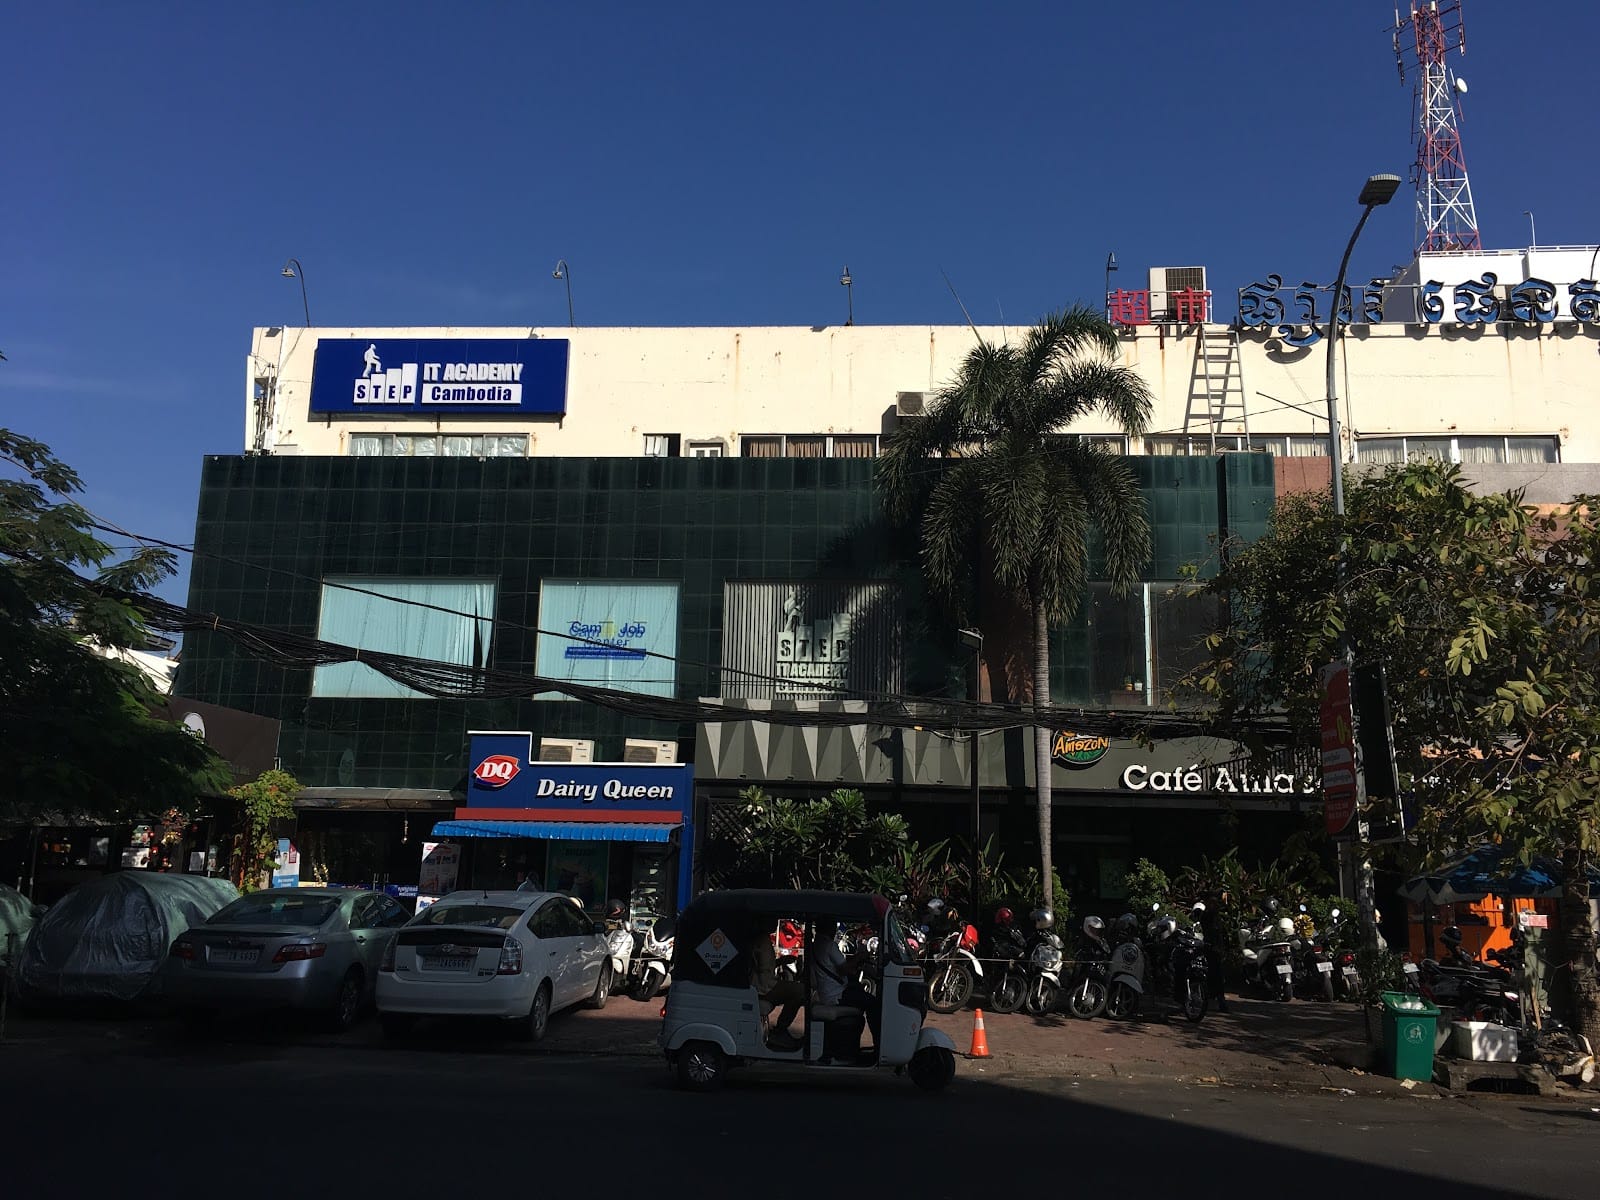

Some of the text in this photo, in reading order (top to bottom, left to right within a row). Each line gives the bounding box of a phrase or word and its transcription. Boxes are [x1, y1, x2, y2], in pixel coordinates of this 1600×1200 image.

[1108, 286, 1212, 325] 超市
[423, 363, 523, 381] IT ACADEMY
[356, 384, 412, 399] STEP
[431, 386, 512, 401] Cambodia
[780, 638, 847, 658] STEP
[791, 663, 848, 678] ACADEMY
[482, 761, 512, 780] DQ
[1123, 764, 1203, 791] Café
[537, 778, 674, 801] Dairy Queen
